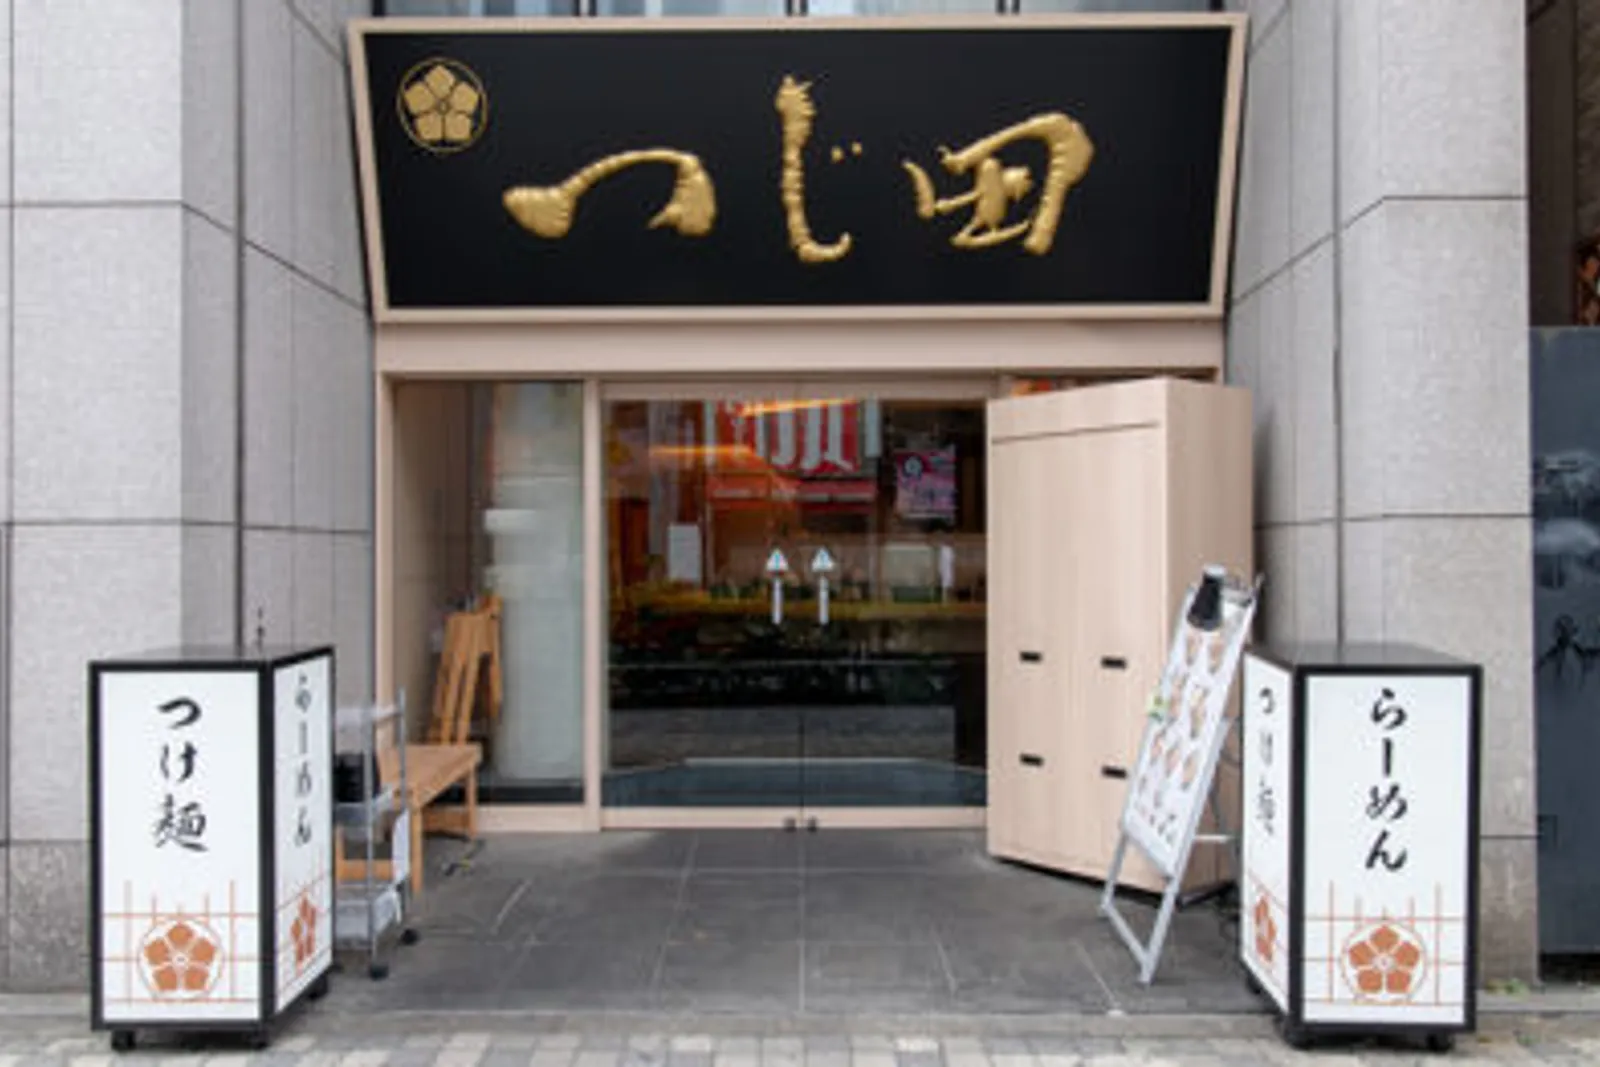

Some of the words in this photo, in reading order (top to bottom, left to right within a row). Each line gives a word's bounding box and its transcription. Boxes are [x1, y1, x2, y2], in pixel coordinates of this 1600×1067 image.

[502, 75, 1094, 264] つじ田
[154, 696, 208, 852] つけ麺
[1363, 687, 1410, 873] らーめん
